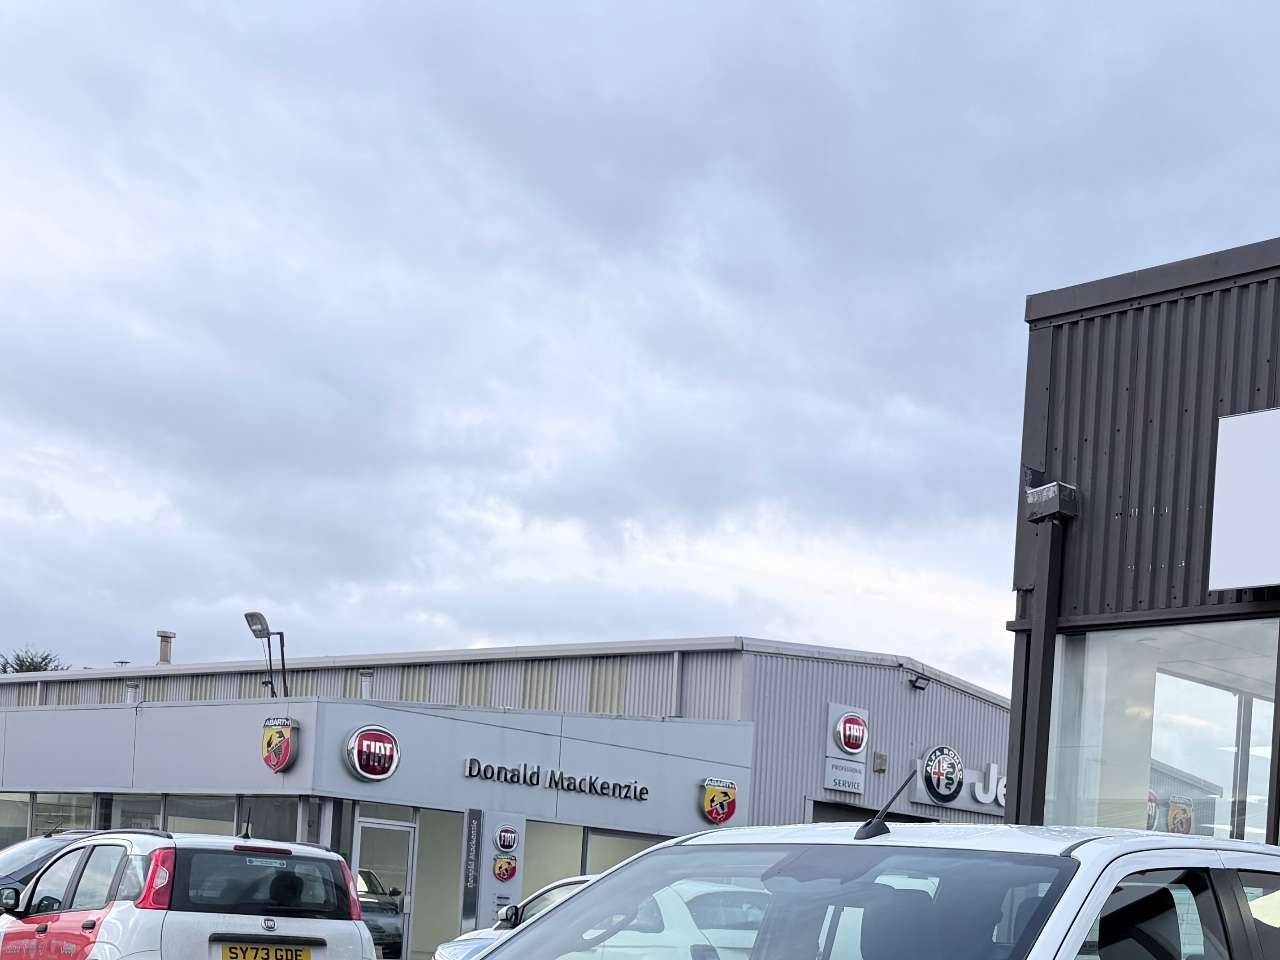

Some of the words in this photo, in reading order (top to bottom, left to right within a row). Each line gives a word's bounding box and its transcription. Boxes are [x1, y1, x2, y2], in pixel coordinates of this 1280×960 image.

[846, 723, 864, 744] FIAT
[362, 740, 393, 768] FIAT
[926, 750, 941, 772] ALFA
[943, 748, 963, 779] ROMEO
[466, 757, 541, 786] Donald
[548, 769, 649, 801] MacKenzie
[833, 778, 861, 790] SERVICE
[501, 832, 515, 846] FIAT
[229, 946, 270, 960] SY73
